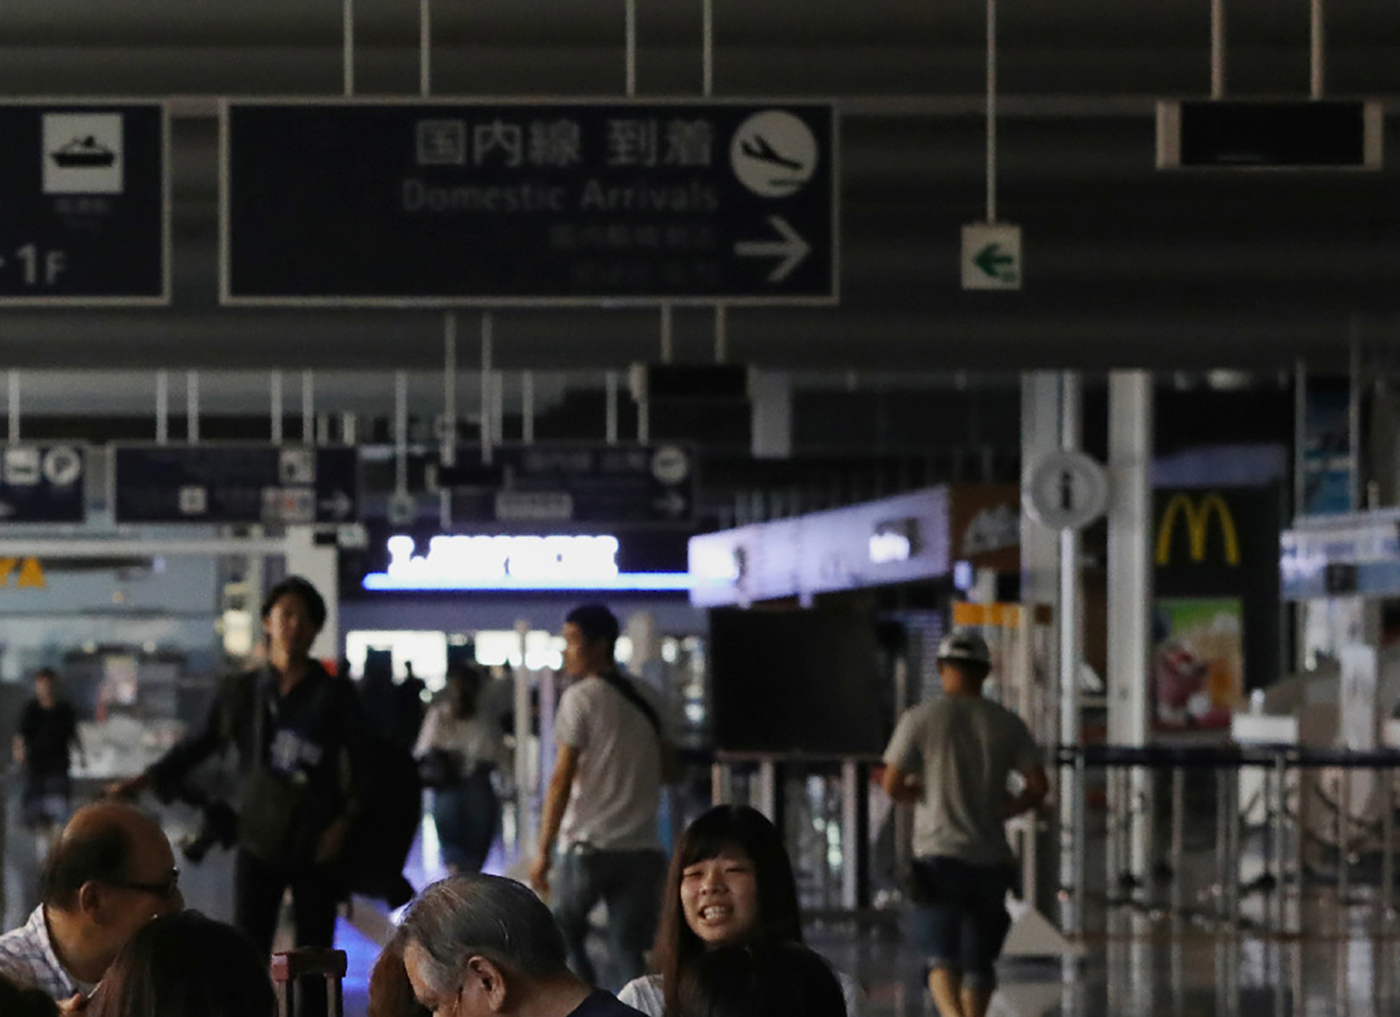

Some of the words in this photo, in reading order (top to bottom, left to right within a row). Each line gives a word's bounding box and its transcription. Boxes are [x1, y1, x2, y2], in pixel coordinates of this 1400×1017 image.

[416, 119, 580, 167] 国内線
[607, 119, 713, 167] 到着
[402, 178, 567, 212] Domestic
[580, 178, 720, 212] Arrivals
[16, 243, 66, 285] 1F
